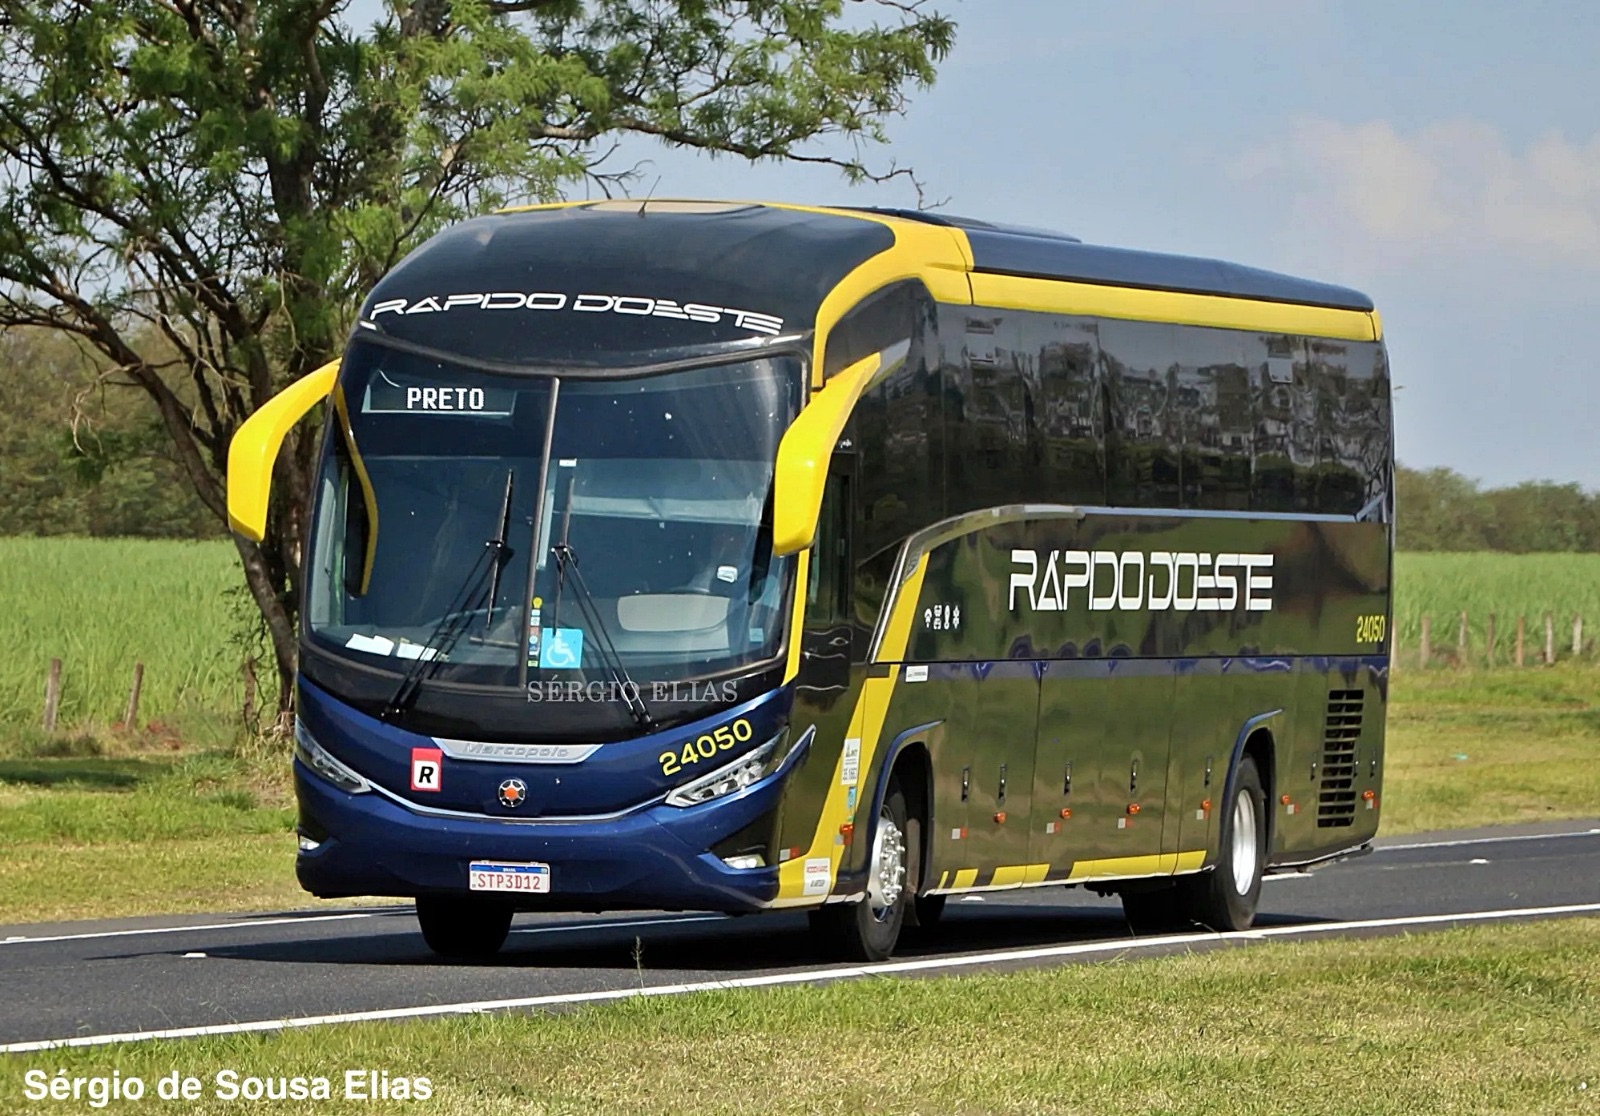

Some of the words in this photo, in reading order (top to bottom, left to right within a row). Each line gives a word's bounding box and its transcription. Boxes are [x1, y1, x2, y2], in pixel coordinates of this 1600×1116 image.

[370, 292, 567, 320] RÁPIDO
[406, 387, 485, 410] PRETO
[1009, 549, 1145, 611] RÁPIDO
[1356, 615, 1386, 643] 24050
[462, 743, 570, 758] Marcopolo
[659, 719, 752, 776] 24050
[418, 765, 435, 784] R
[477, 873, 541, 890] STP3D12
